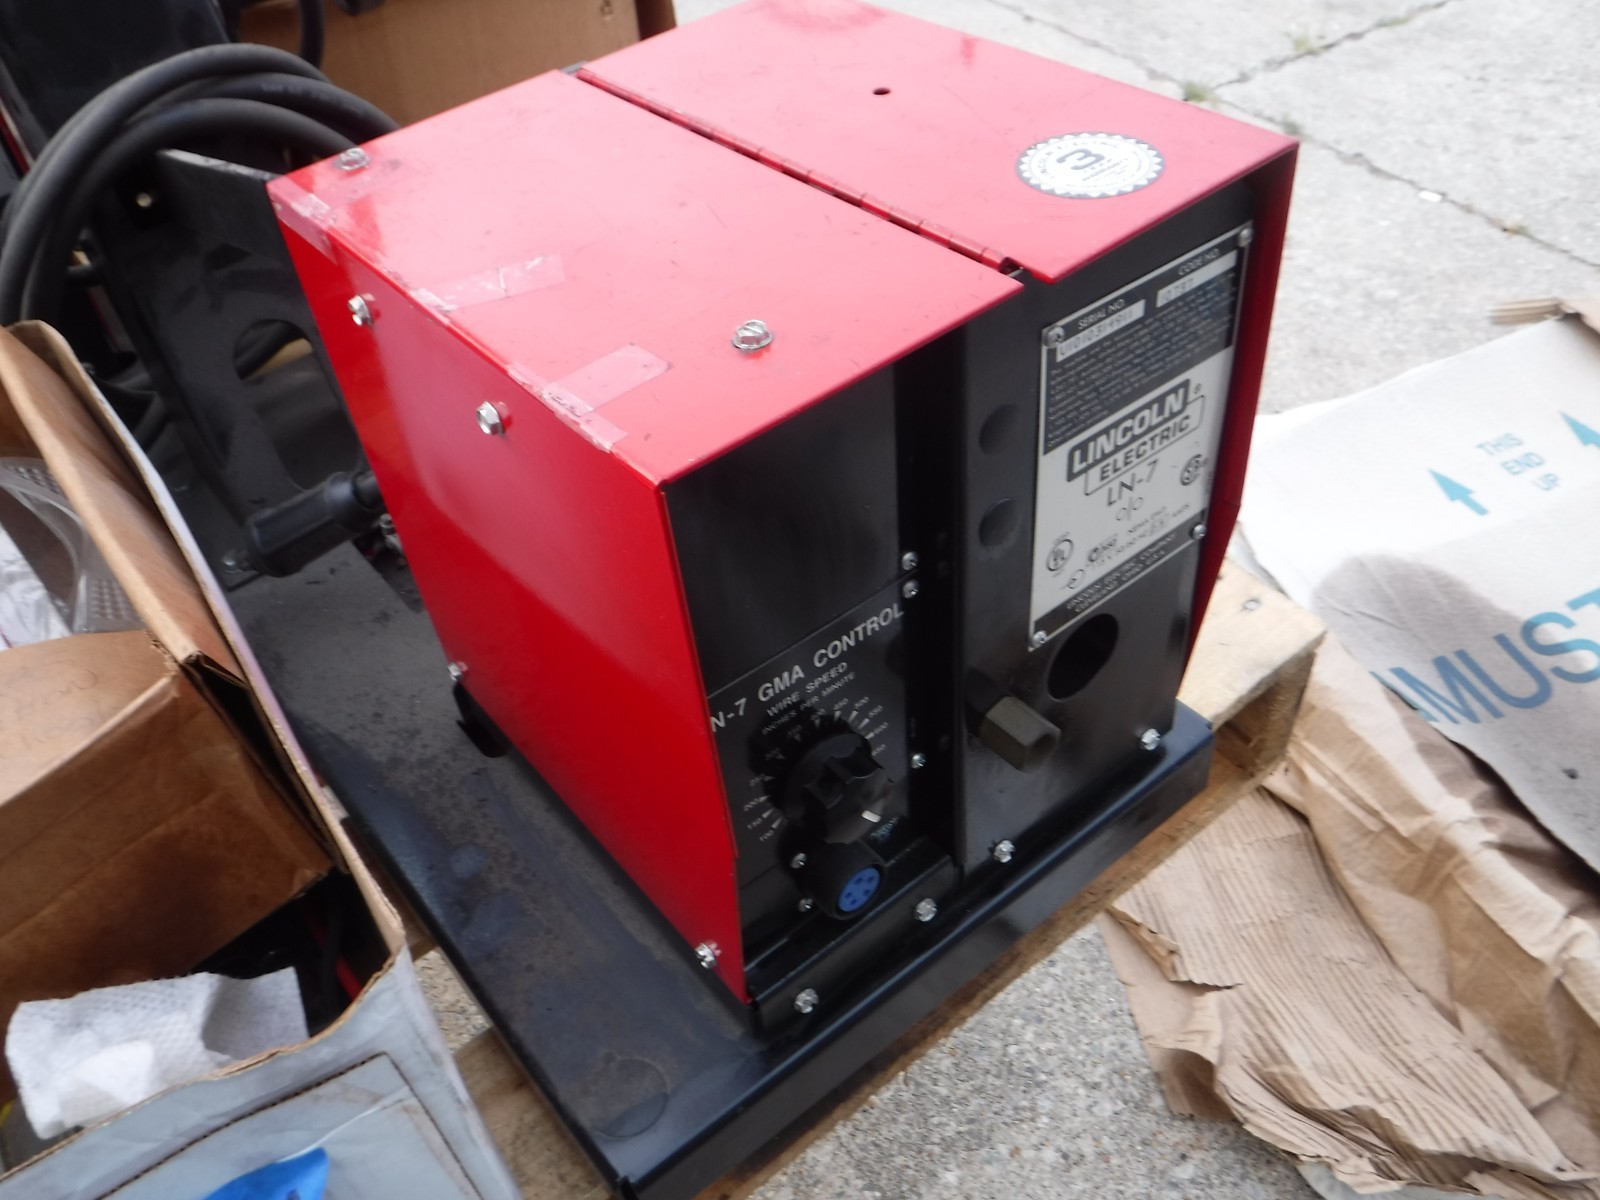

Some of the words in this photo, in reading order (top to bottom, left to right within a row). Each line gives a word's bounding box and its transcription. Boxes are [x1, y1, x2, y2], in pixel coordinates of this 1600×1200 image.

[1056, 148, 1105, 171] 3
[1077, 308, 1107, 330] SERIAL
[1072, 386, 1186, 475] LINCOLN
[1099, 413, 1191, 482] ELECTRIC
[1475, 432, 1525, 456] THIS
[1501, 451, 1546, 475] END
[1107, 458, 1159, 507] LN-7
[1531, 472, 1562, 491] UP
[709, 697, 748, 733] N-7
[757, 664, 806, 702] GMA
[812, 602, 905, 668] CONTROL
[766, 691, 801, 717] WIRE
[805, 661, 848, 693] SPEED
